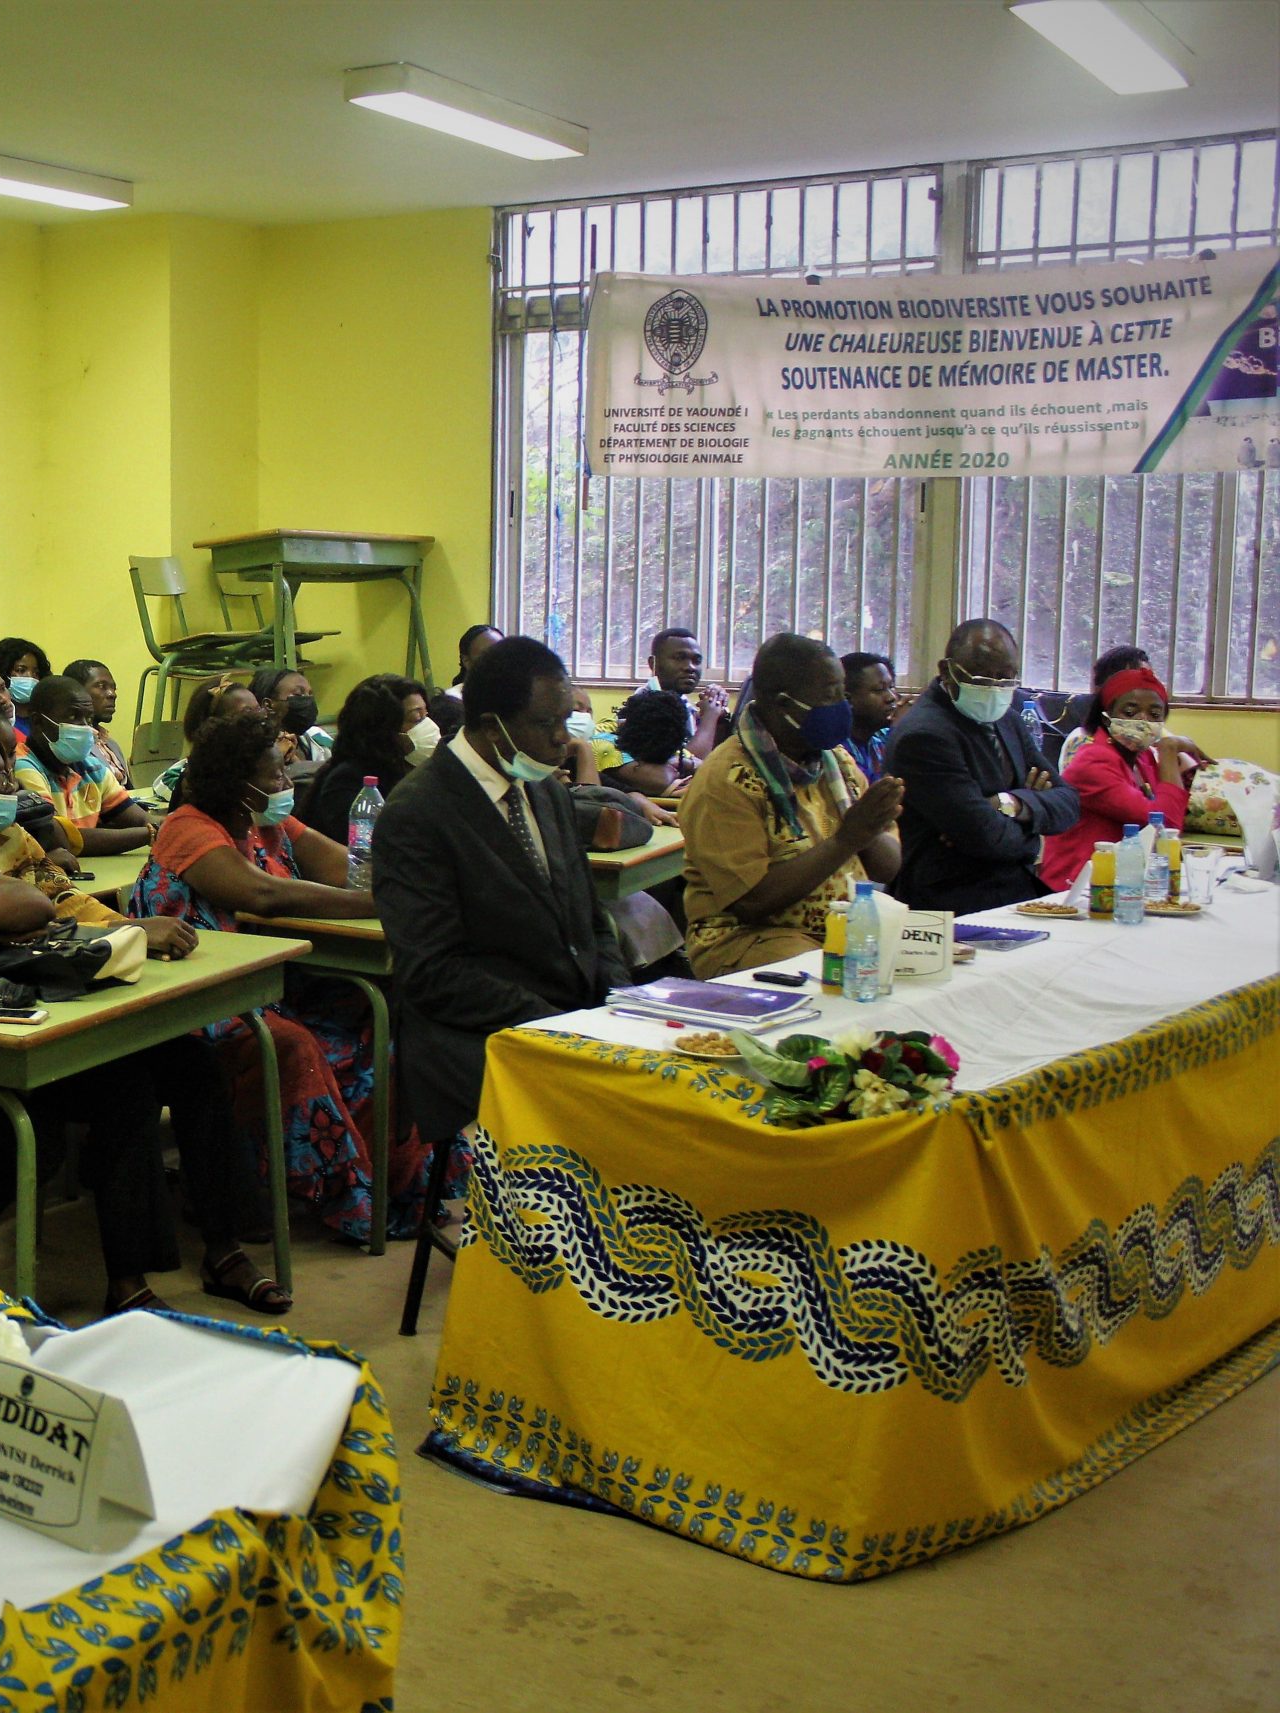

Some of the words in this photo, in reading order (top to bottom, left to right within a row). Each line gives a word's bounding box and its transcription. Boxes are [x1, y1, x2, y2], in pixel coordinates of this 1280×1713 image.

[756, 298, 779, 317] LA
[781, 299, 893, 320] PROMOTION
[898, 295, 1031, 319] BIODIVERSITE
[1036, 290, 1095, 315] VOUS
[1101, 276, 1212, 307] SOUHAITE
[785, 332, 825, 352] UNE
[829, 330, 963, 353] CHALEUREUSE
[969, 325, 1083, 352] BIENVENUE
[1088, 320, 1103, 346] À
[1110, 318, 1173, 344] CETTE
[781, 366, 902, 390] SOUTENANCE
[908, 365, 933, 388] DE
[938, 360, 1036, 386] MÉMOIRE
[1043, 360, 1069, 383] DE
[1076, 353, 1169, 381] MASTER.
[604, 405, 665, 418] UNIVERSITÉ
[668, 407, 683, 417] DE
[686, 405, 741, 417] YAOUNDÉ
[744, 407, 748, 417] I
[778, 409, 798, 420] Les
[802, 408, 860, 422] perdants
[864, 407, 956, 420] abandonnent
[960, 405, 1005, 420] quand
[1010, 405, 1026, 417] ils
[1031, 402, 1102, 416] échouent
[613, 421, 657, 433] FACULTÉ
[661, 423, 681, 433] DES
[684, 422, 736, 433] SCIENCES
[772, 426, 791, 438] les
[794, 427, 853, 440] gagnants
[857, 425, 922, 438] échouent
[980, 425, 996, 436] ce
[1000, 422, 1040, 438] qu'ils
[599, 436, 676, 448] DÉPARTEMENT
[680, 438, 694, 448] DE
[697, 438, 749, 448] BIOLOGIE
[604, 454, 616, 463] ET
[619, 454, 689, 464] PHYSIOLOGIE
[692, 454, 744, 464] ANIMALE
[883, 449, 953, 469] ANNÉE
[959, 452, 1010, 469] 2020
[31, 1455, 76, 1485] Derrick
